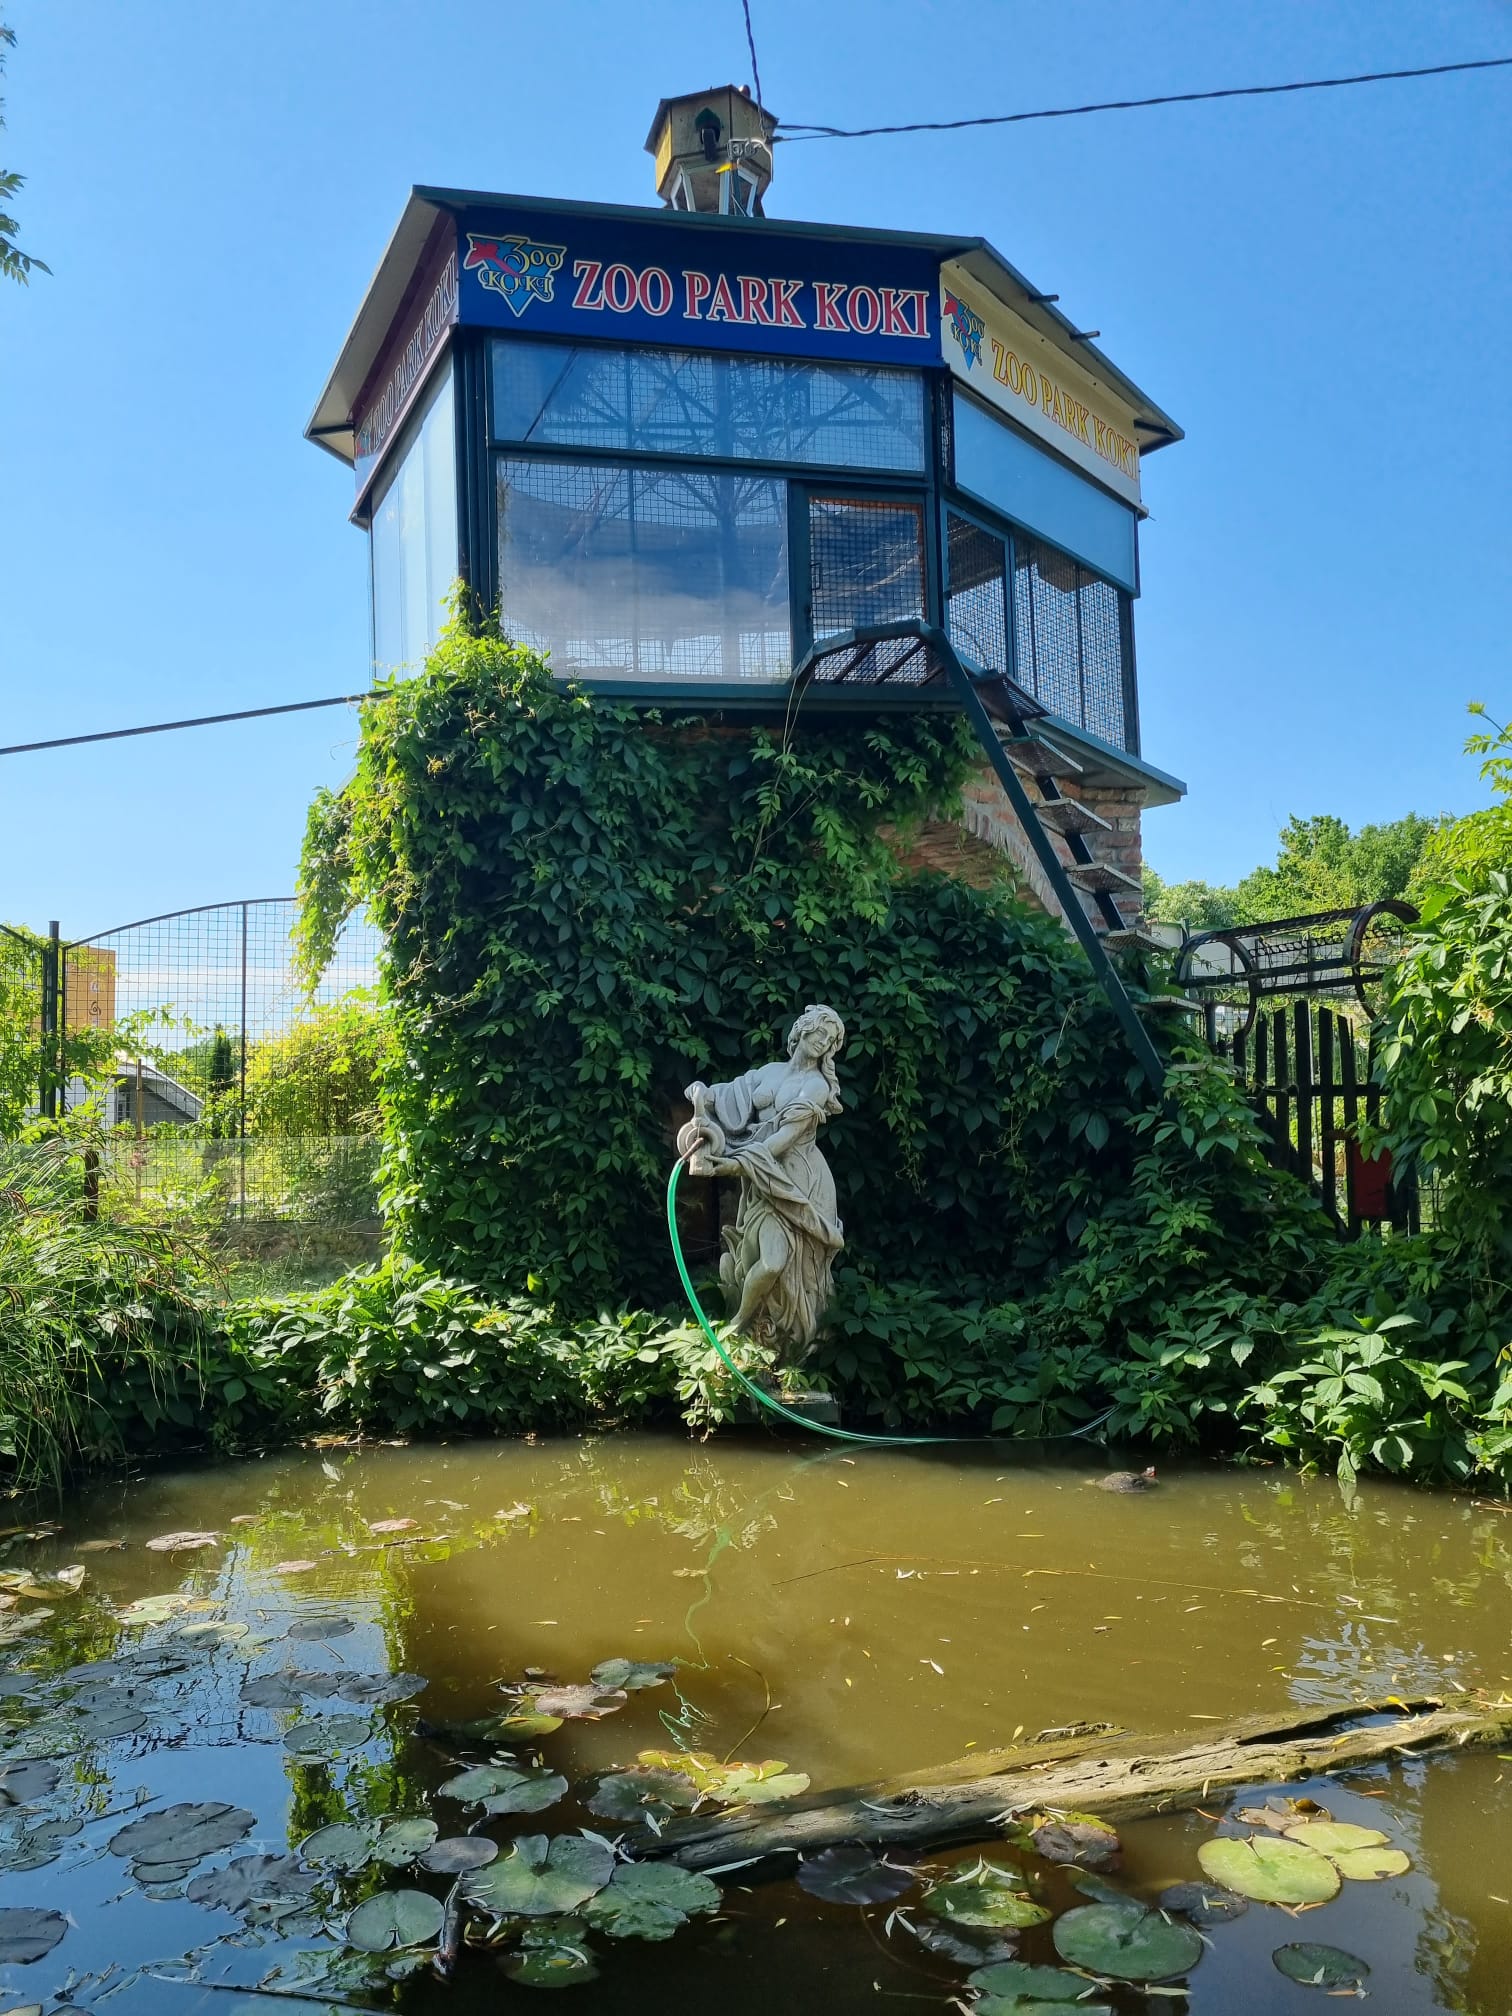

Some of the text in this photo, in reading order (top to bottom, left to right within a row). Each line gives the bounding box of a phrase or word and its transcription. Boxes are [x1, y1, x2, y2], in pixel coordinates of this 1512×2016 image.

[373, 381, 394, 454] ZOO
[424, 250, 456, 358] KOKI
[571, 260, 931, 339] ZOO PARK KOKI
[991, 338, 1138, 481] ZOO PARK KOKI
